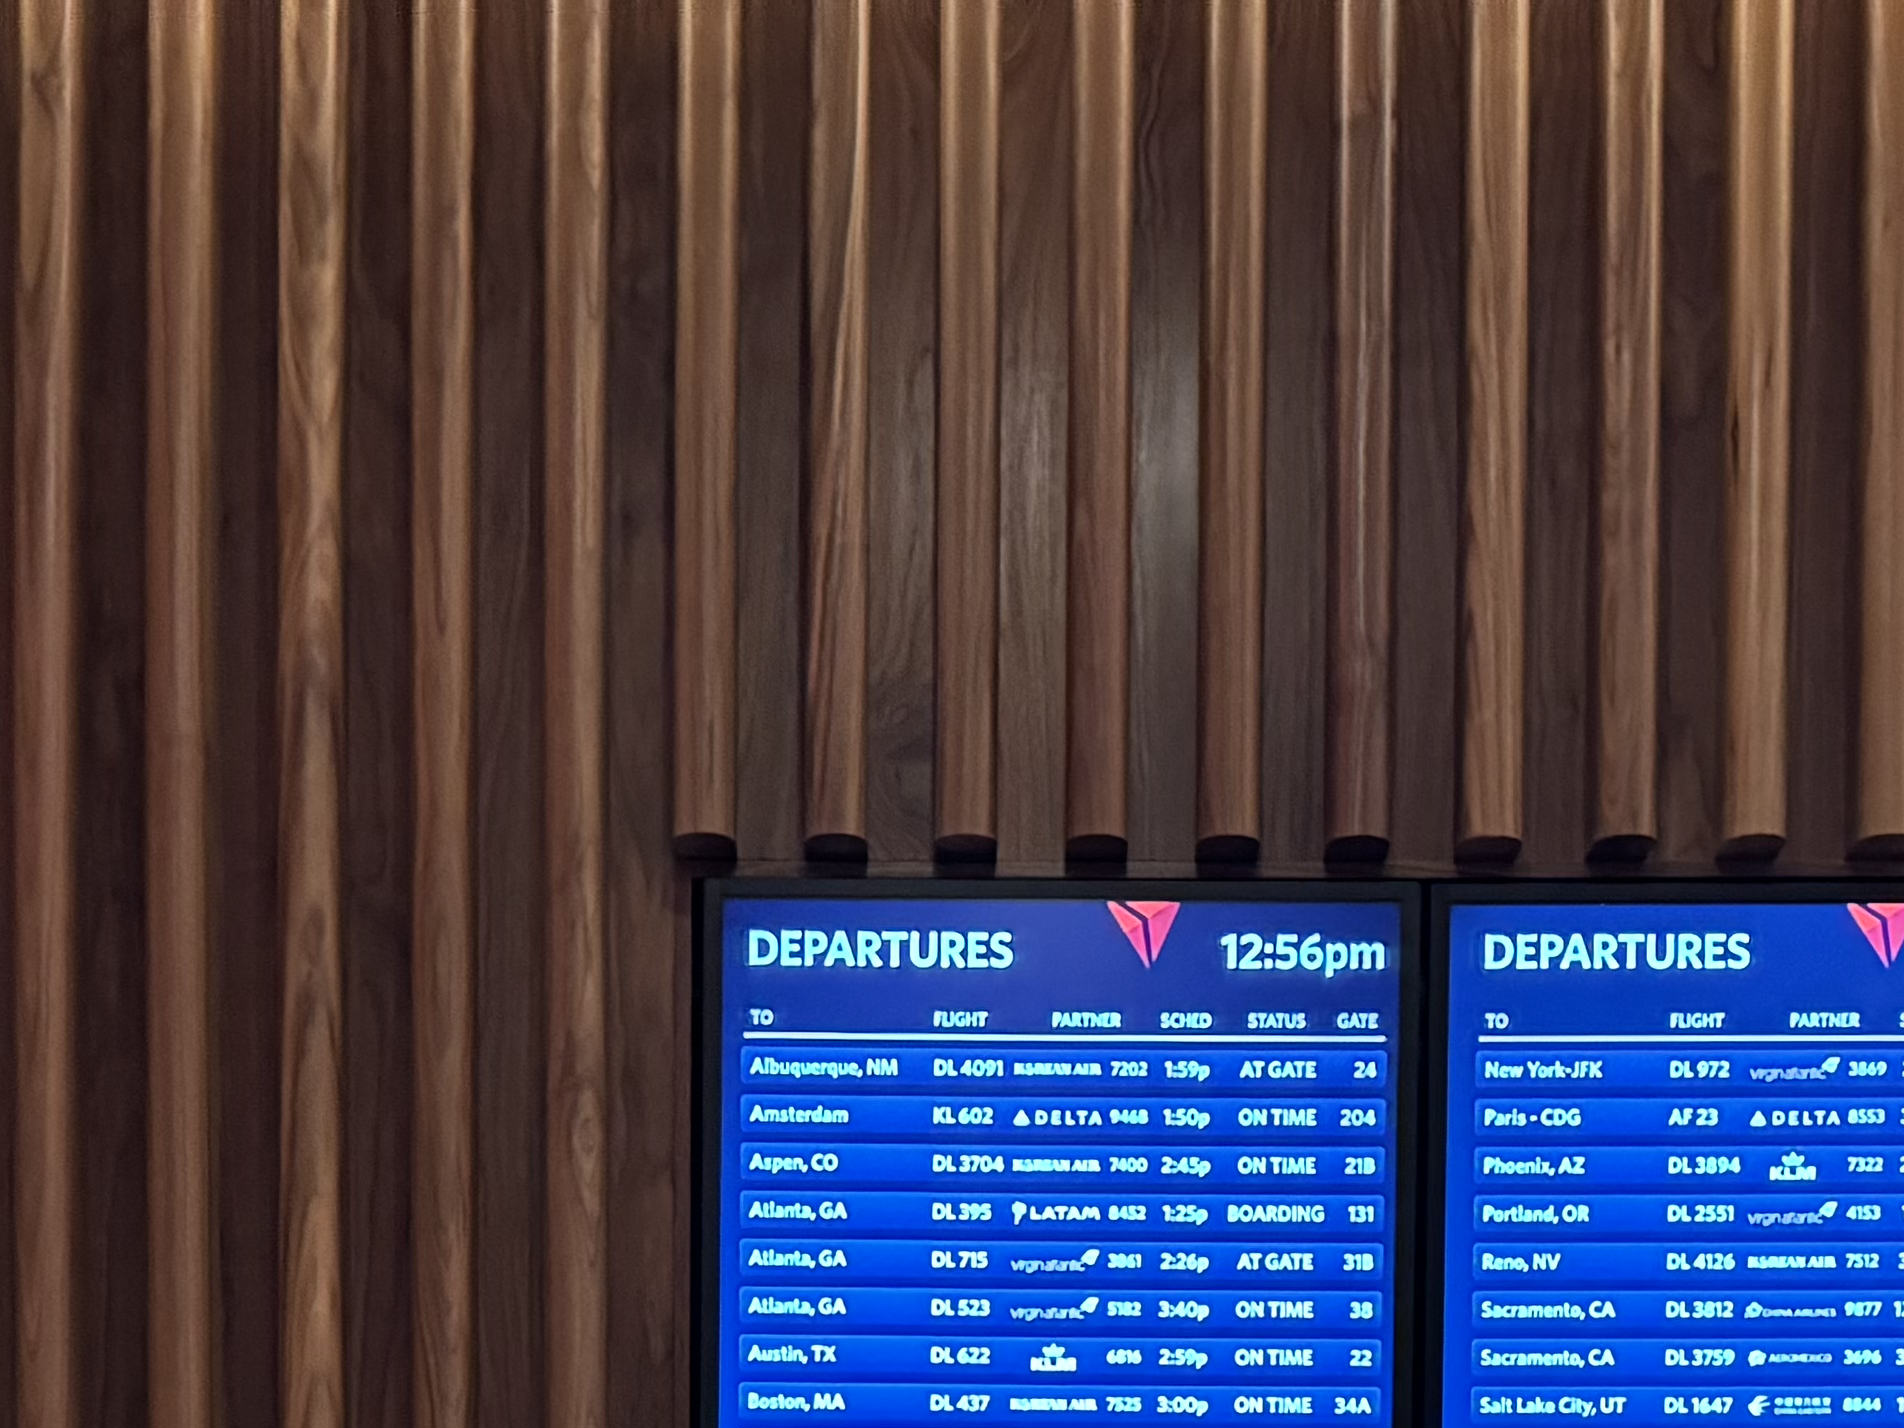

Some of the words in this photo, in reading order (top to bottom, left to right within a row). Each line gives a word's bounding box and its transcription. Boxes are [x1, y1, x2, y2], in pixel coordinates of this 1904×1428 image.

[748, 929, 1014, 969] DEPARTURES
[1220, 932, 1385, 979] 12:56pm
[1484, 932, 1751, 970] DEPARTURES
[747, 1008, 775, 1027] TO
[933, 1010, 989, 1028] FLIGHT
[1051, 1011, 1122, 1028] PARTNER
[1160, 1012, 1213, 1029] SCHED
[1247, 1012, 1307, 1029] STATUS
[1336, 1012, 1379, 1030] GATE
[1484, 1012, 1509, 1029] TO
[1669, 1012, 1726, 1029] FLIGHT
[1789, 1012, 1861, 1028] PARTNER
[749, 1056, 864, 1079] Albuquerque,
[866, 1058, 899, 1076] NM
[933, 1058, 958, 1077] DL
[959, 1059, 1004, 1077] 4091
[1164, 1060, 1211, 1082] 1:59p
[1239, 1060, 1266, 1079] AT
[1267, 1060, 1317, 1079] GATE
[1353, 1061, 1377, 1079] 24
[1484, 1061, 1524, 1079] New
[1527, 1060, 1603, 1079] York-JFK
[1669, 1060, 1695, 1079] DL
[1696, 1060, 1730, 1079] 972
[749, 1104, 849, 1123] Amsterdam
[932, 1106, 957, 1125] KL
[957, 1106, 994, 1125] 602
[1034, 1109, 1103, 1126] DELTA
[1163, 1107, 1211, 1130] 1:50p
[1238, 1107, 1268, 1127] ON
[1270, 1108, 1317, 1127] TIME
[1340, 1108, 1377, 1127] 204
[749, 1152, 809, 1174] Aspen,
[810, 1153, 839, 1172] CO
[932, 1154, 957, 1173] DL
[959, 1154, 1005, 1173] 3704
[1160, 1156, 1212, 1178] 2:45p
[1237, 1156, 1267, 1175] ON
[1269, 1156, 1317, 1175] TIME
[1344, 1157, 1376, 1175] 21B
[748, 1200, 817, 1221] Atlanta,
[818, 1201, 848, 1220] GA
[931, 1202, 957, 1221] DL
[958, 1202, 992, 1221] 395
[1029, 1205, 1101, 1221] LATAM
[1162, 1204, 1209, 1226] 1:25p
[1227, 1204, 1325, 1223] BOARDING
[1347, 1205, 1375, 1223] 131
[1482, 1252, 1529, 1273] Reno,
[1532, 1253, 1561, 1271] NV
[1666, 1252, 1691, 1271] DL
[1693, 1252, 1736, 1270] 4126
[747, 1344, 809, 1365] Austin,
[810, 1344, 837, 1363] TX
[930, 1346, 955, 1364] DL
[956, 1346, 991, 1365] 622
[1158, 1348, 1209, 1370] 2:59p
[1234, 1348, 1264, 1366] ON
[1266, 1348, 1314, 1367] TIME
[1349, 1349, 1373, 1367] 22
